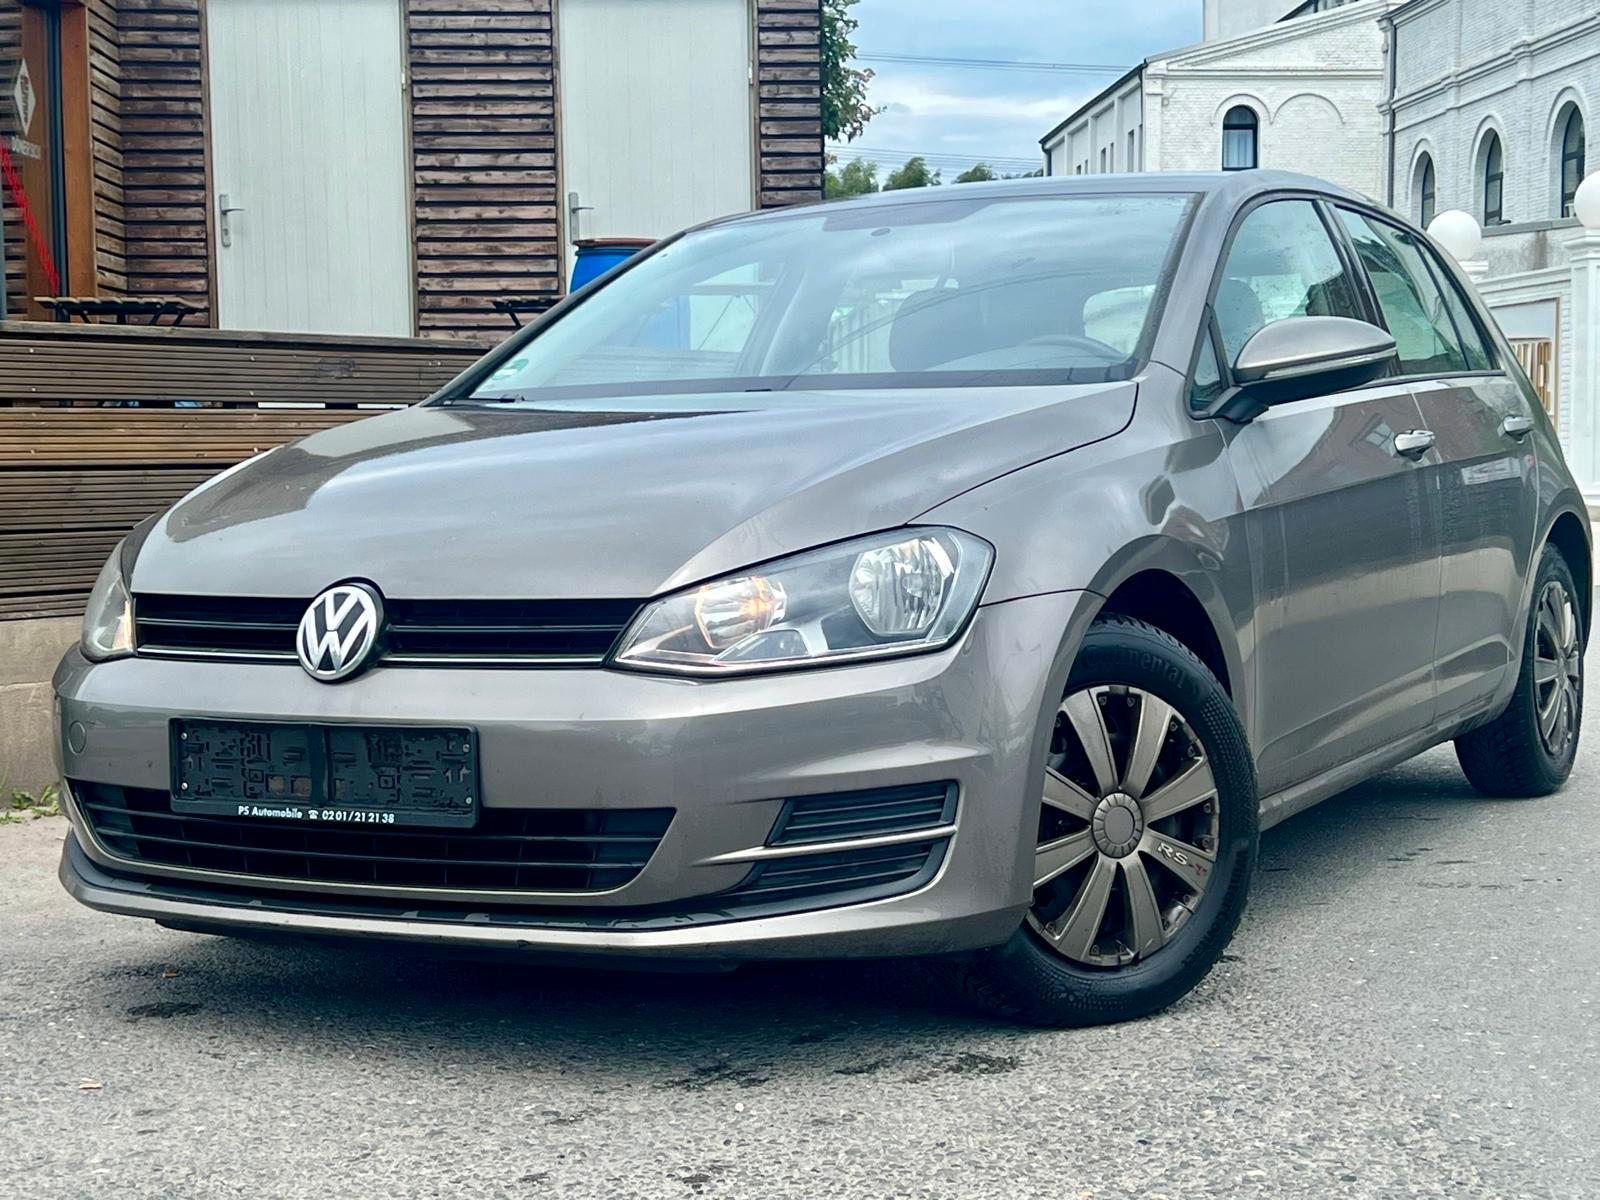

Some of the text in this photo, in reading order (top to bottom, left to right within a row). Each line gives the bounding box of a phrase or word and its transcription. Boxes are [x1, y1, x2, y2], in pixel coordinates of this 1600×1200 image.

[297, 585, 377, 680] VW
[1081, 643, 1185, 689] Ctinental
[238, 805, 250, 816] PS
[251, 806, 303, 819] Automobile
